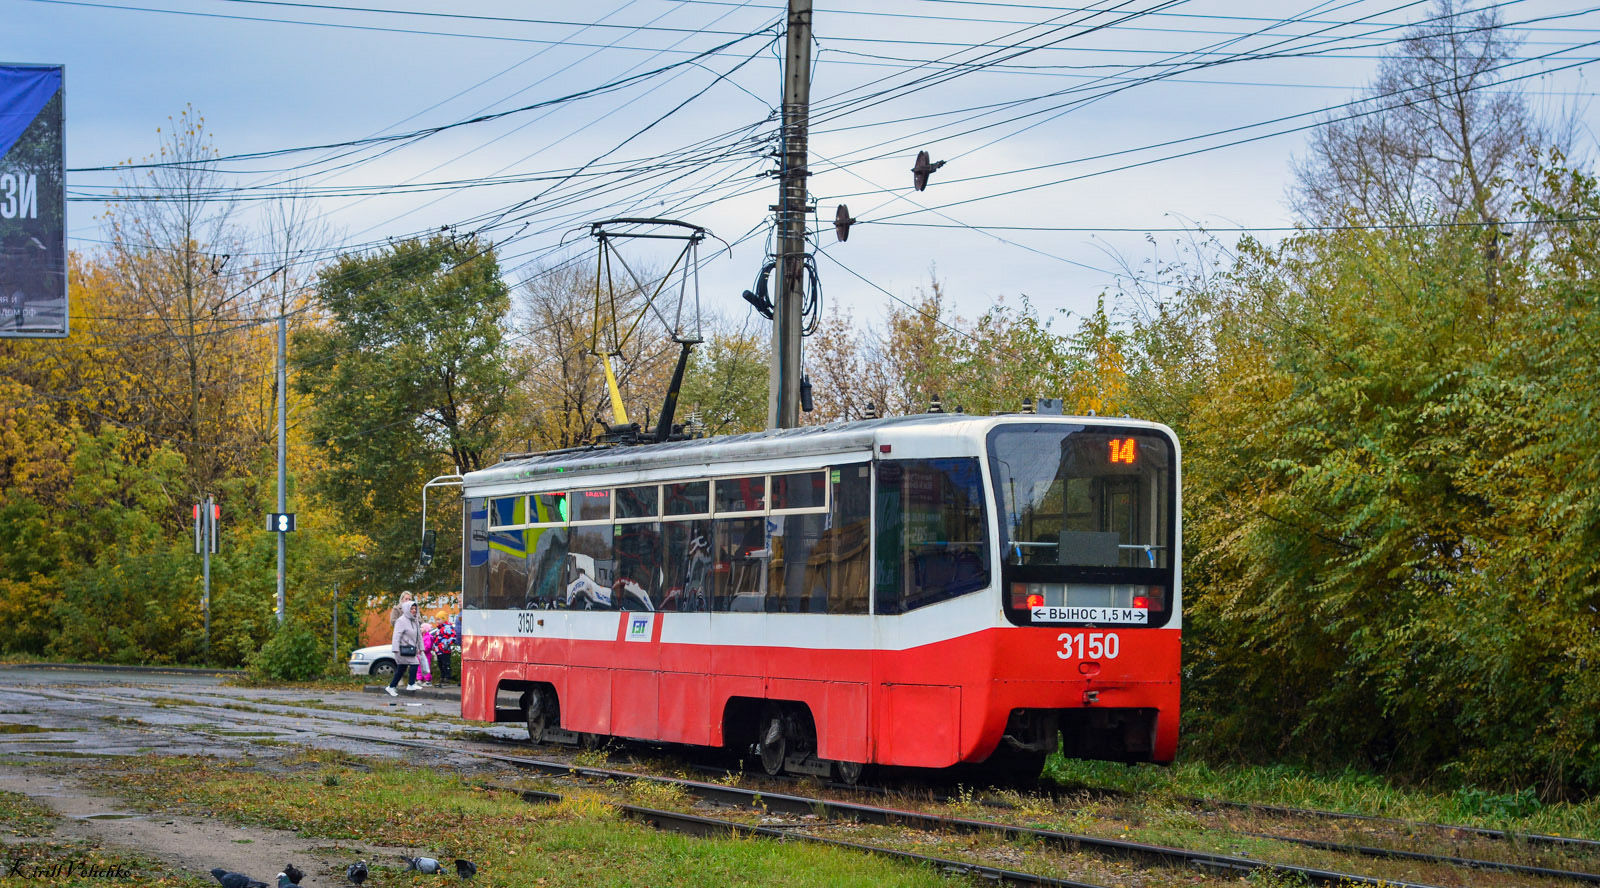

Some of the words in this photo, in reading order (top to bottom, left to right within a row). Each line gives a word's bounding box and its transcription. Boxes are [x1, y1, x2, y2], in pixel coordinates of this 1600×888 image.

[1109, 438, 1136, 463] 14
[518, 612, 534, 633] 3150
[1049, 608, 1098, 621] ВЫНОС
[1102, 609, 1119, 623] 1,5
[1122, 610, 1133, 622] М
[1056, 633, 1120, 659] 3150
